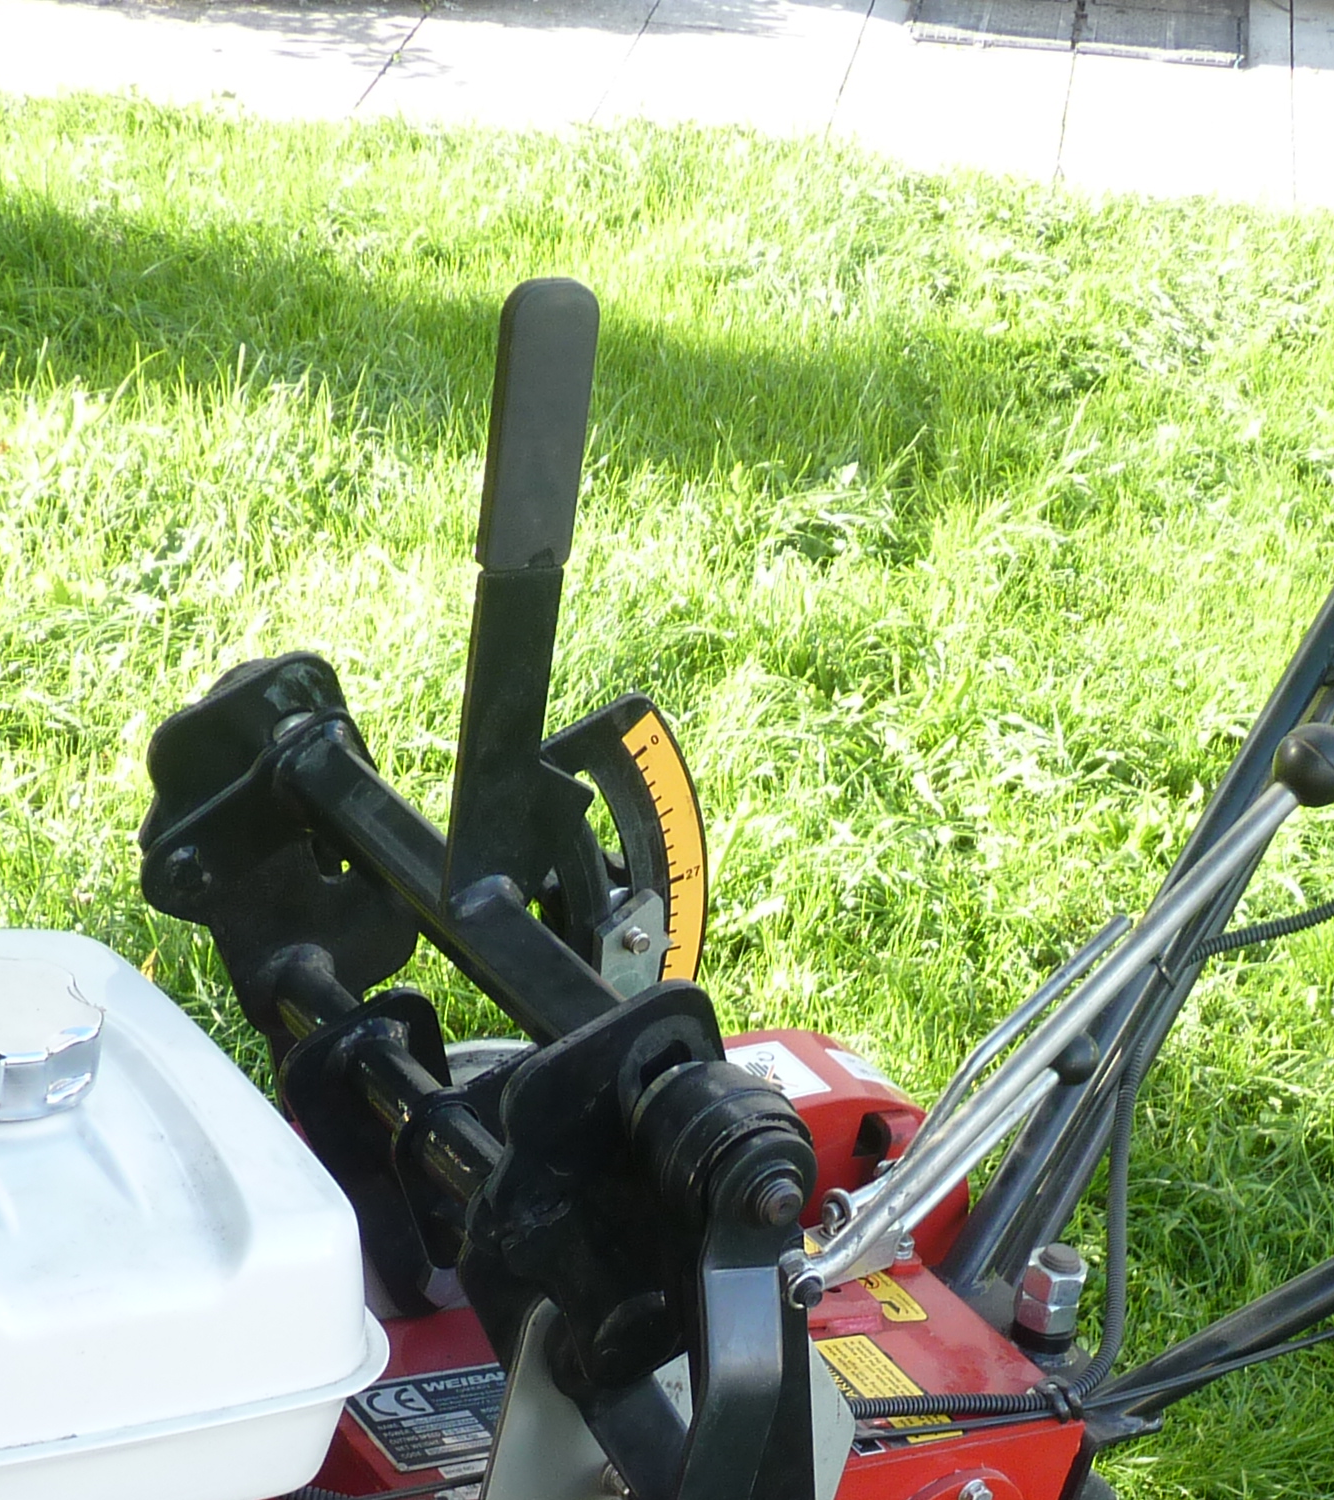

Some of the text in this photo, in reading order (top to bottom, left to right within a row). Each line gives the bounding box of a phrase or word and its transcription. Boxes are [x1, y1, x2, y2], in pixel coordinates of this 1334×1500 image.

[651, 735, 659, 745] 0
[685, 865, 701, 880] 27
[366, 1387, 426, 1416] CE
